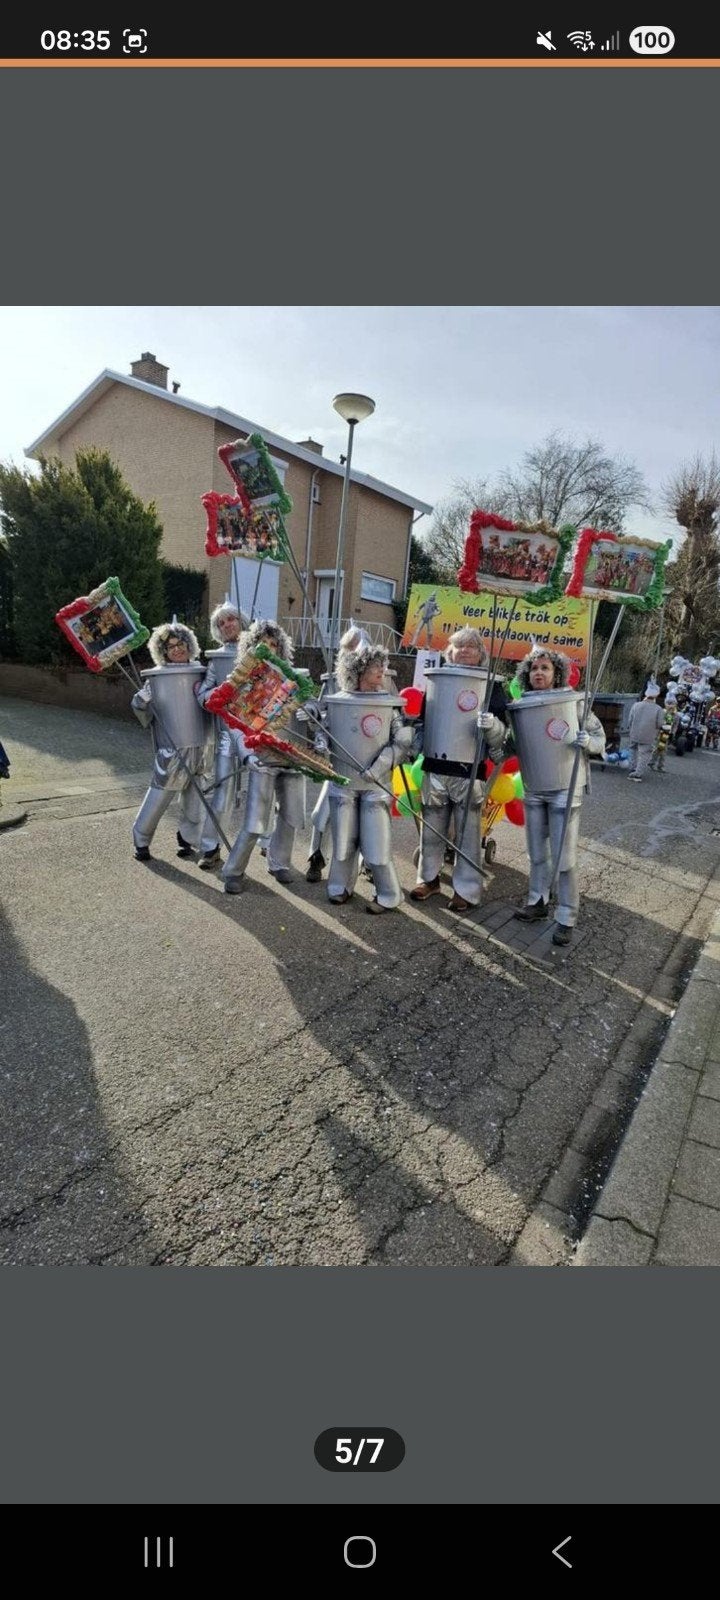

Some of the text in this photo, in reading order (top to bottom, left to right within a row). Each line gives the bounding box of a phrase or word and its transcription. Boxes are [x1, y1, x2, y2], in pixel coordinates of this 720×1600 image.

[463, 605, 486, 617] Veer
[525, 610, 550, 624] trök
[553, 614, 569, 627] op
[553, 635, 584, 648] same
[424, 658, 436, 669] 31
